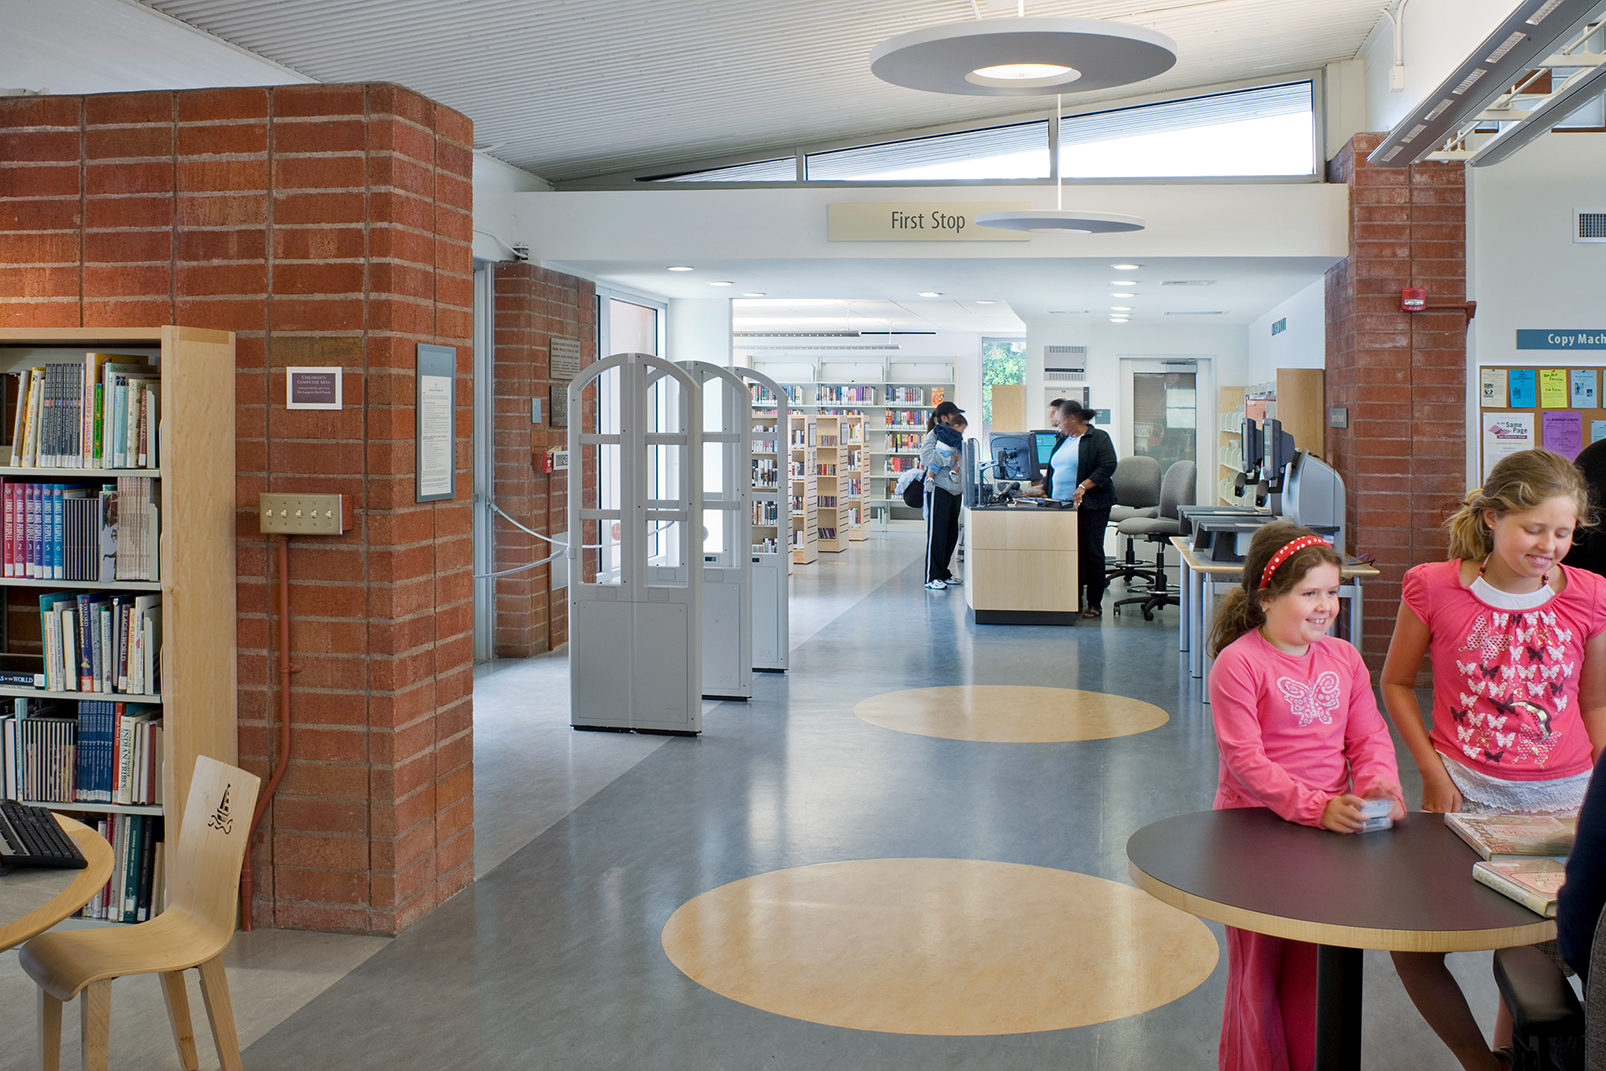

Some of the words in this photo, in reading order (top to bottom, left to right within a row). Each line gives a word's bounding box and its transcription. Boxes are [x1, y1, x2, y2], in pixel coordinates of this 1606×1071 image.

[891, 211, 924, 229] First
[931, 211, 966, 233] Stop
[1548, 334, 1575, 346] Copy
[121, 728, 129, 758] INDIAN
